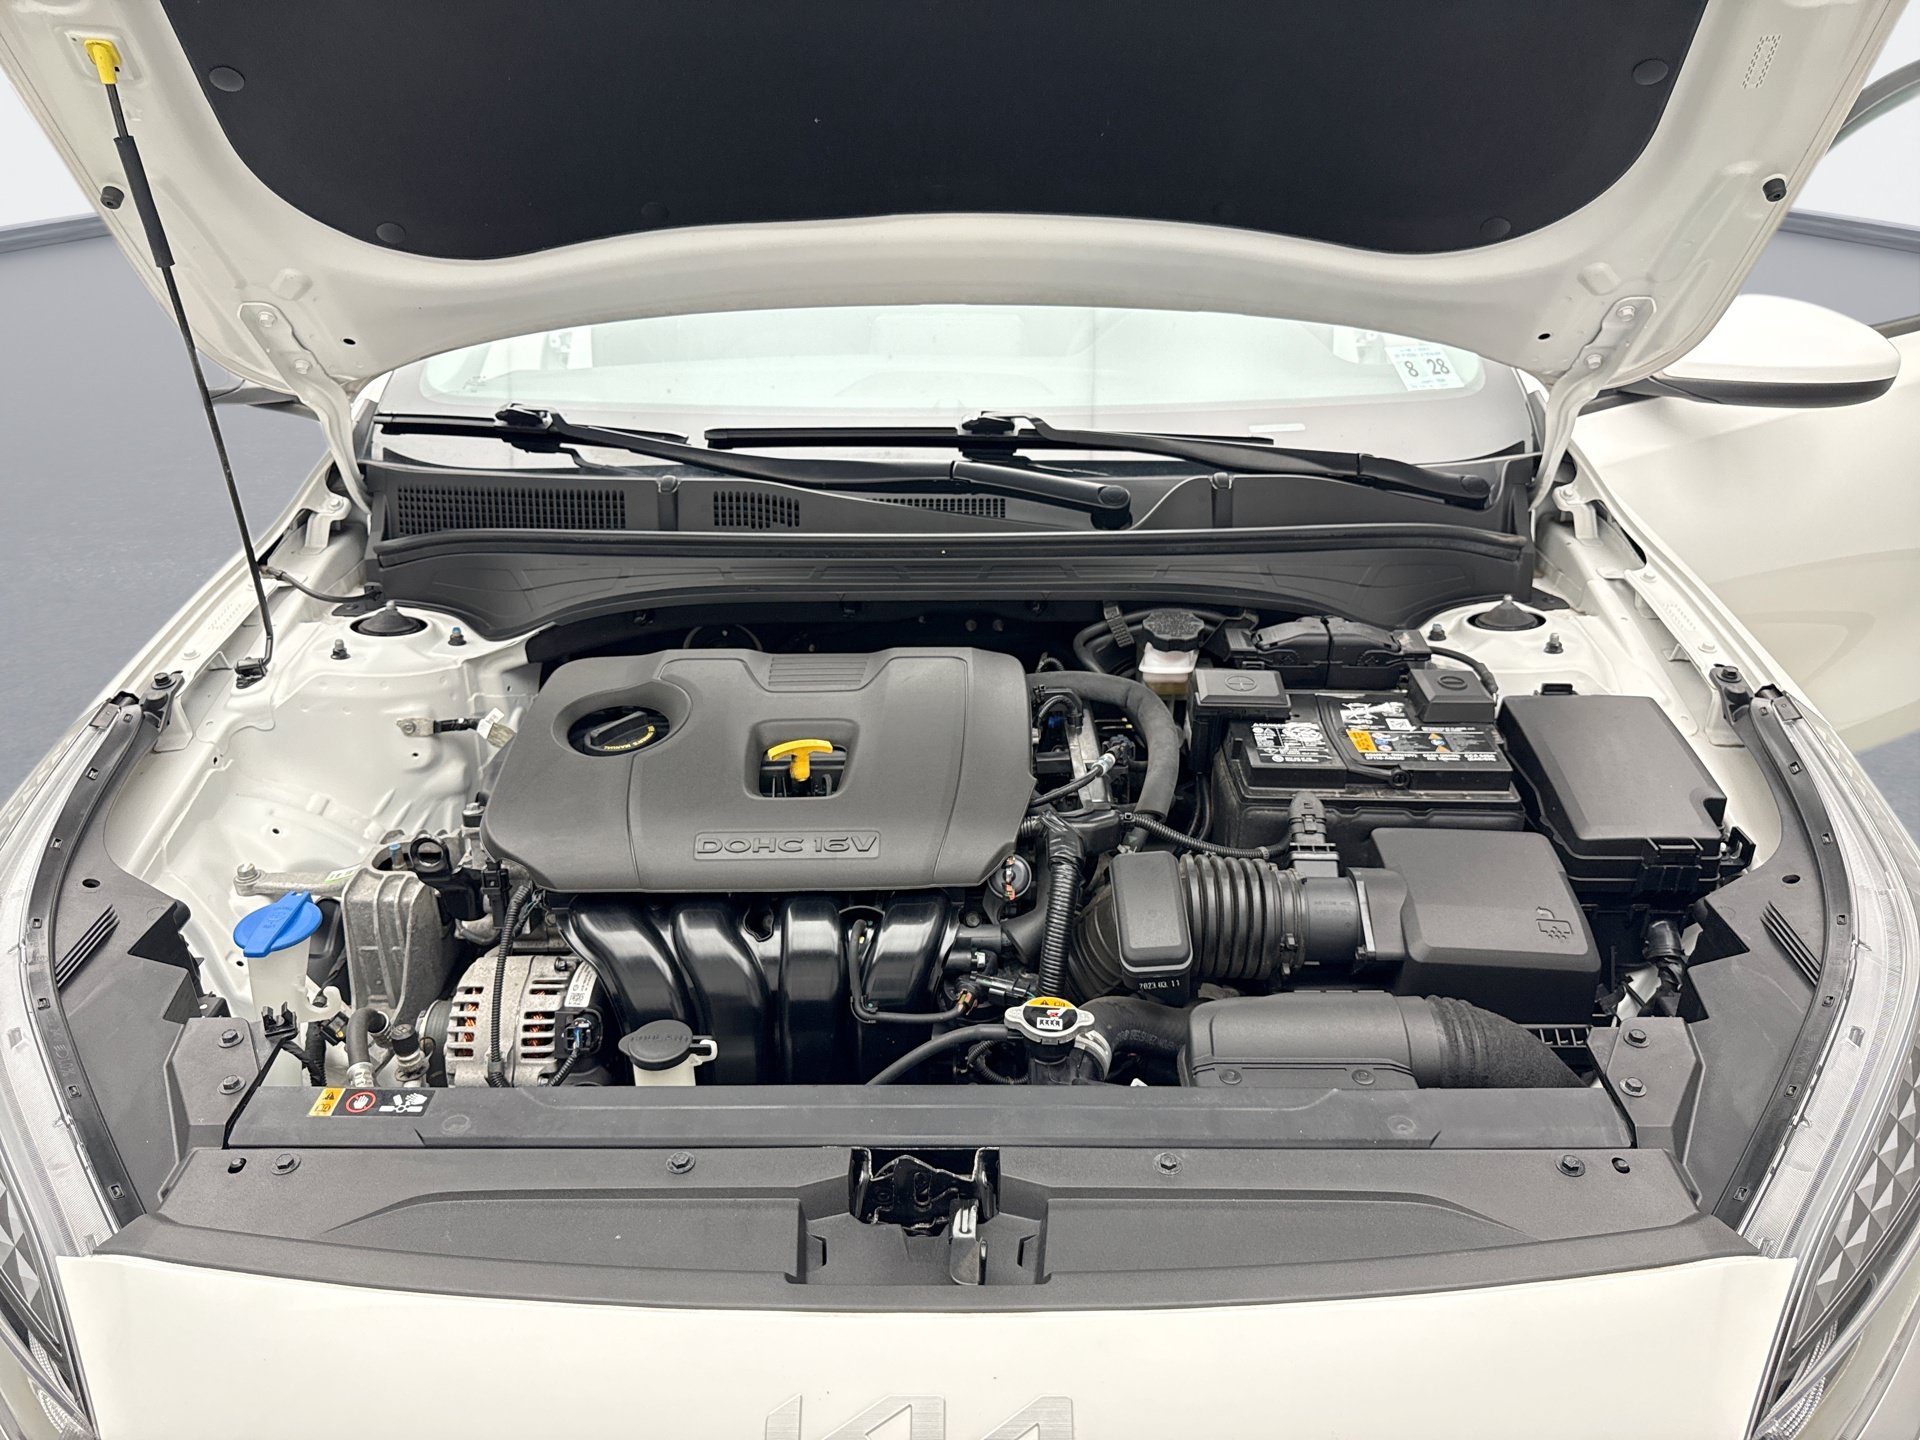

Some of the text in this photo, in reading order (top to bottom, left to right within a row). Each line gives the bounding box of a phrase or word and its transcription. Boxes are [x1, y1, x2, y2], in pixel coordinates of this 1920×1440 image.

[1404, 358, 1450, 377] 8 28
[697, 836, 877, 854] DOHC 16V
